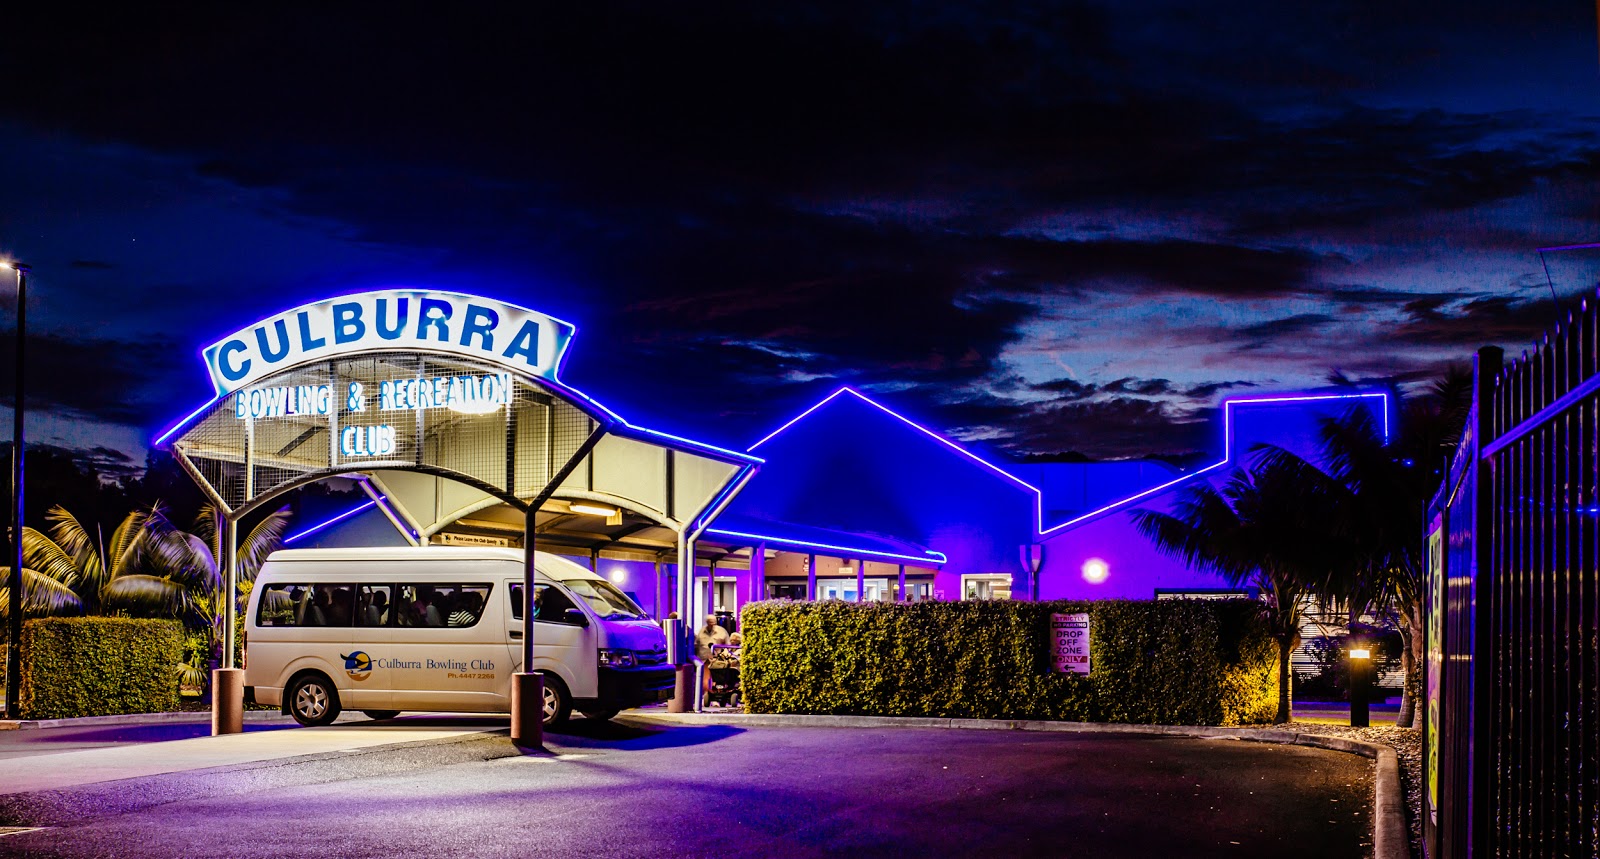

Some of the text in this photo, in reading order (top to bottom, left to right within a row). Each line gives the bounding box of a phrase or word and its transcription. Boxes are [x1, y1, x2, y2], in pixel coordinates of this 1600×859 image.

[218, 297, 540, 383] CULBURRA
[235, 373, 512, 419] BOWLING & RECREATION
[340, 424, 396, 456] CLUB
[378, 658, 495, 672] Culburra Bowling Club
